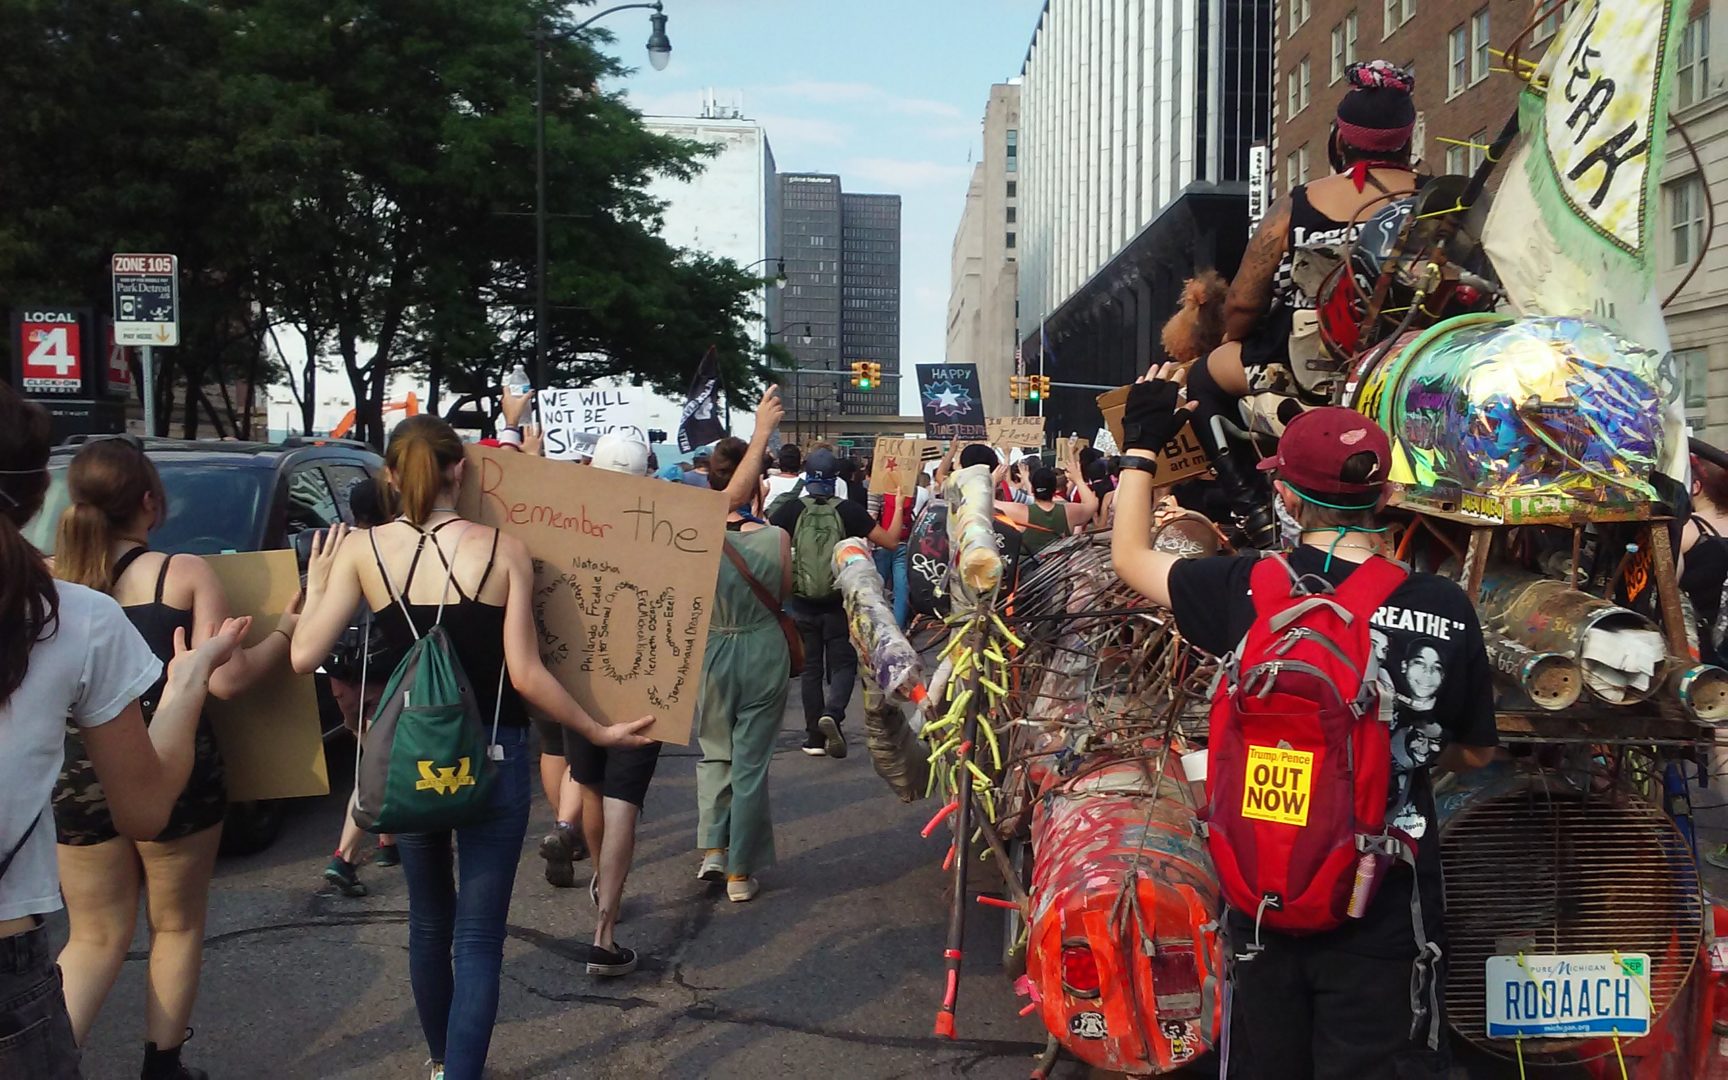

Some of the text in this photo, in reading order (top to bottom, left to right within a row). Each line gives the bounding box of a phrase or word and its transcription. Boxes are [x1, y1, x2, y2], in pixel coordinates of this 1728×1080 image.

[115, 257, 171, 272] ZONE 105
[24, 312, 76, 323] LOCAL
[28, 327, 76, 375] 4
[931, 368, 972, 380] HAPPY
[542, 391, 630, 407] WE WILL
[545, 408, 607, 424] NOT BE
[1011, 417, 1041, 425] PEACE
[1170, 458, 1189, 472] art
[479, 456, 708, 554] Remember the
[572, 556, 621, 575] Natasha
[586, 575, 602, 617] Freddie
[1371, 605, 1466, 641] REATHE"
[580, 624, 598, 672] Philando
[644, 635, 657, 676] Kenneth
[678, 639, 696, 677] Ahmaud
[1253, 764, 1304, 791] OUT
[1246, 786, 1307, 815] NOW
[1556, 961, 1607, 976] MICHIGAN
[1544, 1023, 1591, 1032] michigan.org
